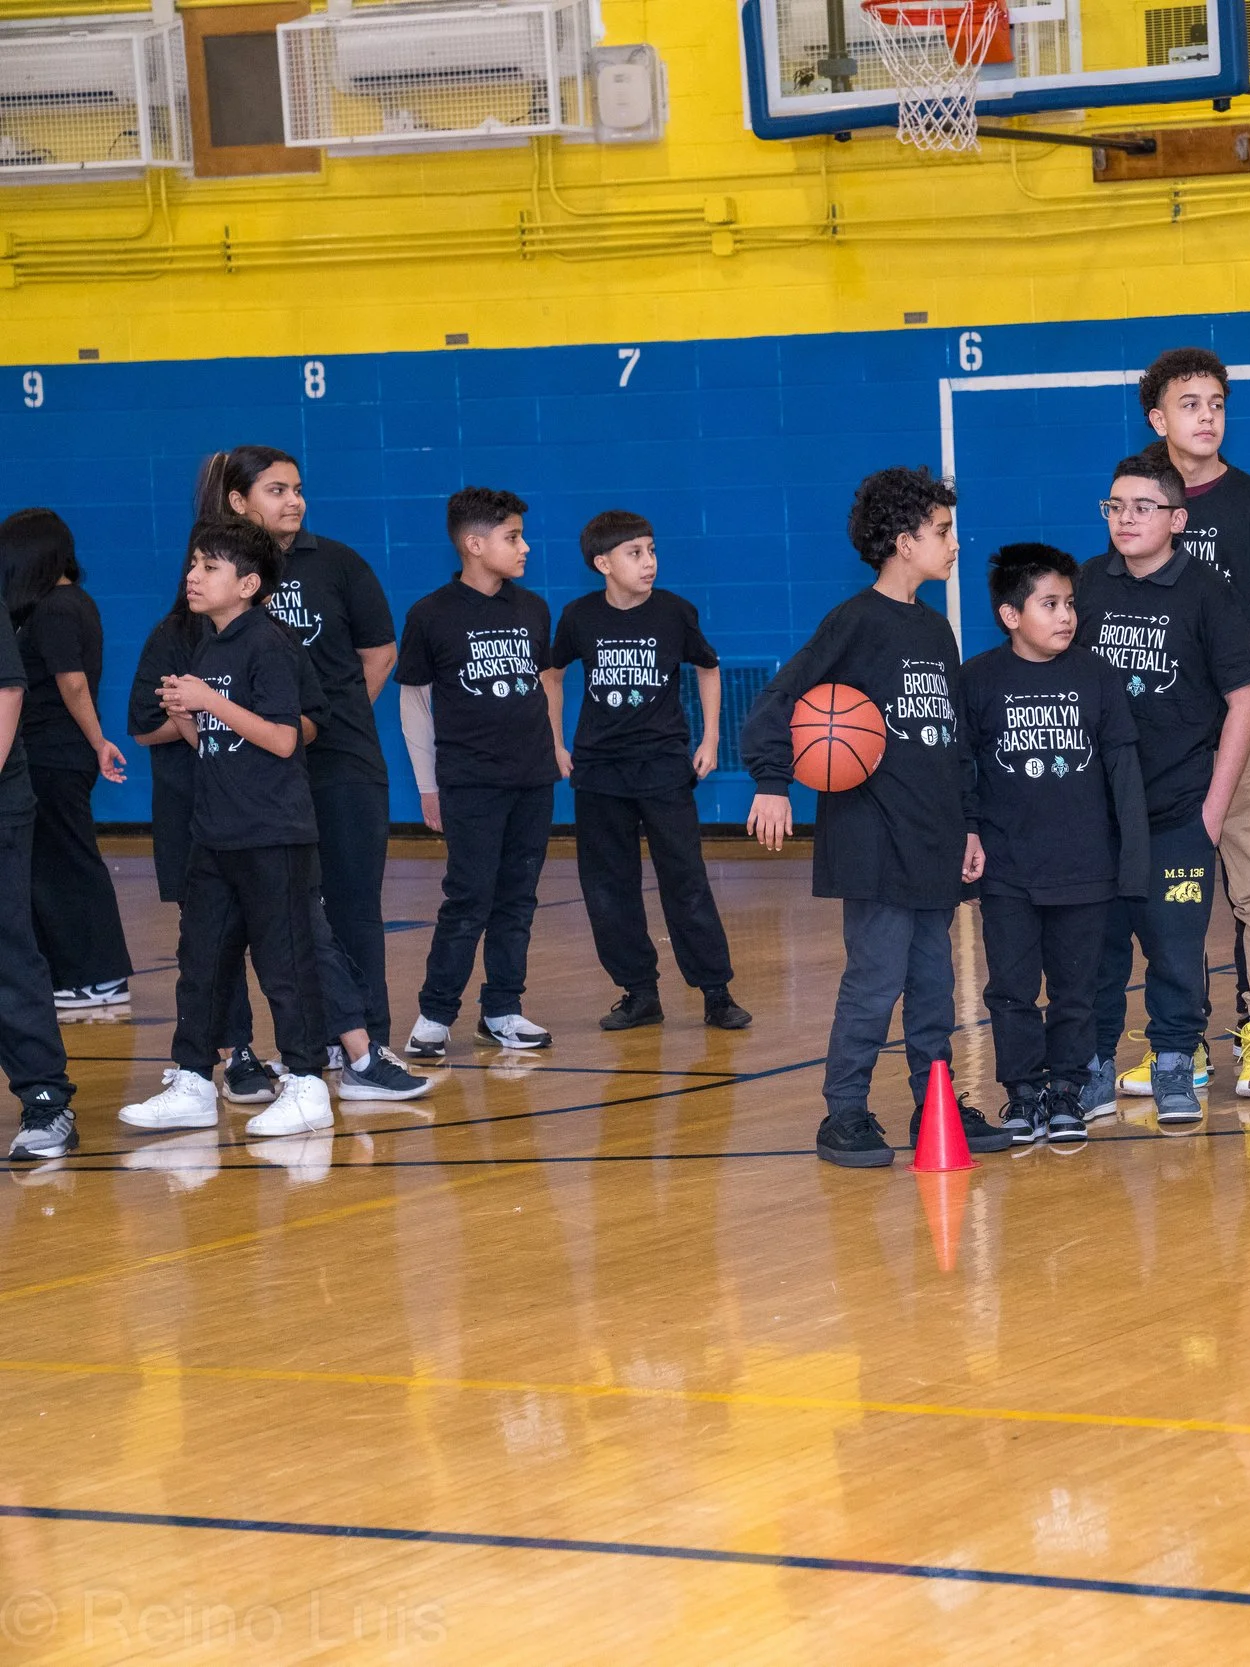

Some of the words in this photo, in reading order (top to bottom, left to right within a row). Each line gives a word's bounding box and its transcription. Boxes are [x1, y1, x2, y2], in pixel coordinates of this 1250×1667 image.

[959, 332, 983, 371] 6
[304, 361, 326, 398] 8
[618, 348, 641, 387] 7
[23, 371, 44, 407] 9
[1099, 624, 1166, 650] BROOKLYN
[470, 639, 530, 660] BROOKLYN
[598, 649, 655, 668] BROOKLYN
[591, 668, 661, 686] BASKETBALL
[1006, 705, 1079, 729] BROOKLYN
[1003, 728, 1086, 752] BASKETBALL
[1164, 868, 1187, 879] M.S.
[1189, 867, 1205, 878] 136
